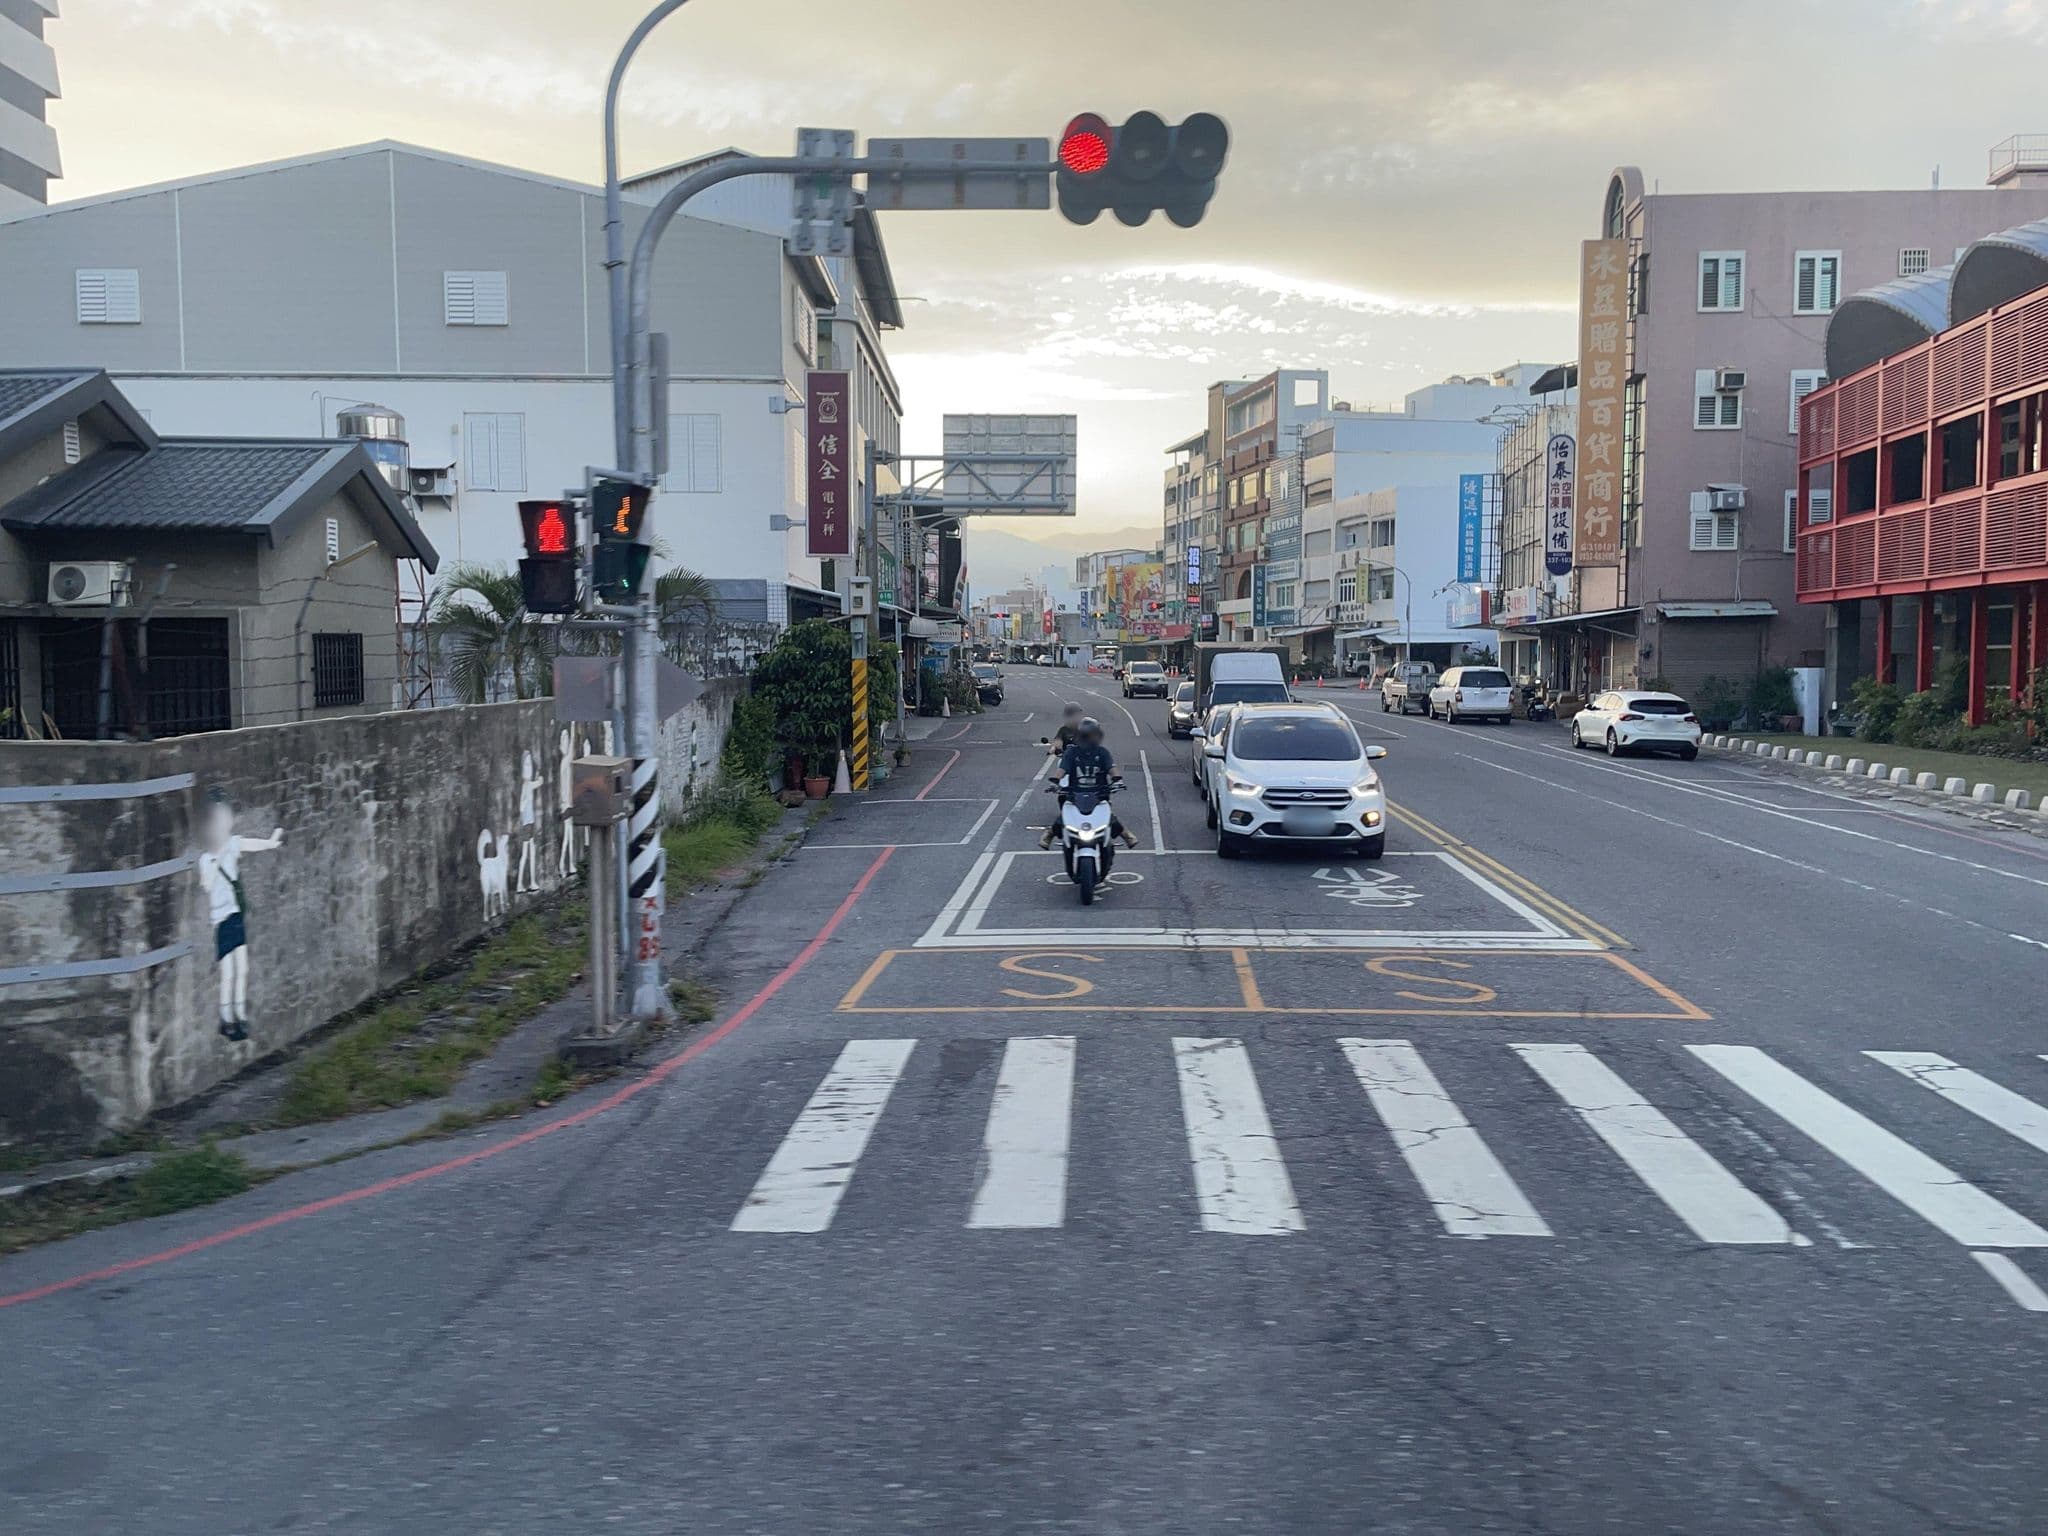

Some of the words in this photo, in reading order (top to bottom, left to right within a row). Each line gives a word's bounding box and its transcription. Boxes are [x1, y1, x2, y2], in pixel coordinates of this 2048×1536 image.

[818, 434, 840, 480] 信全
[1000, 952, 1104, 1000] S
[1366, 956, 1498, 1003] S
